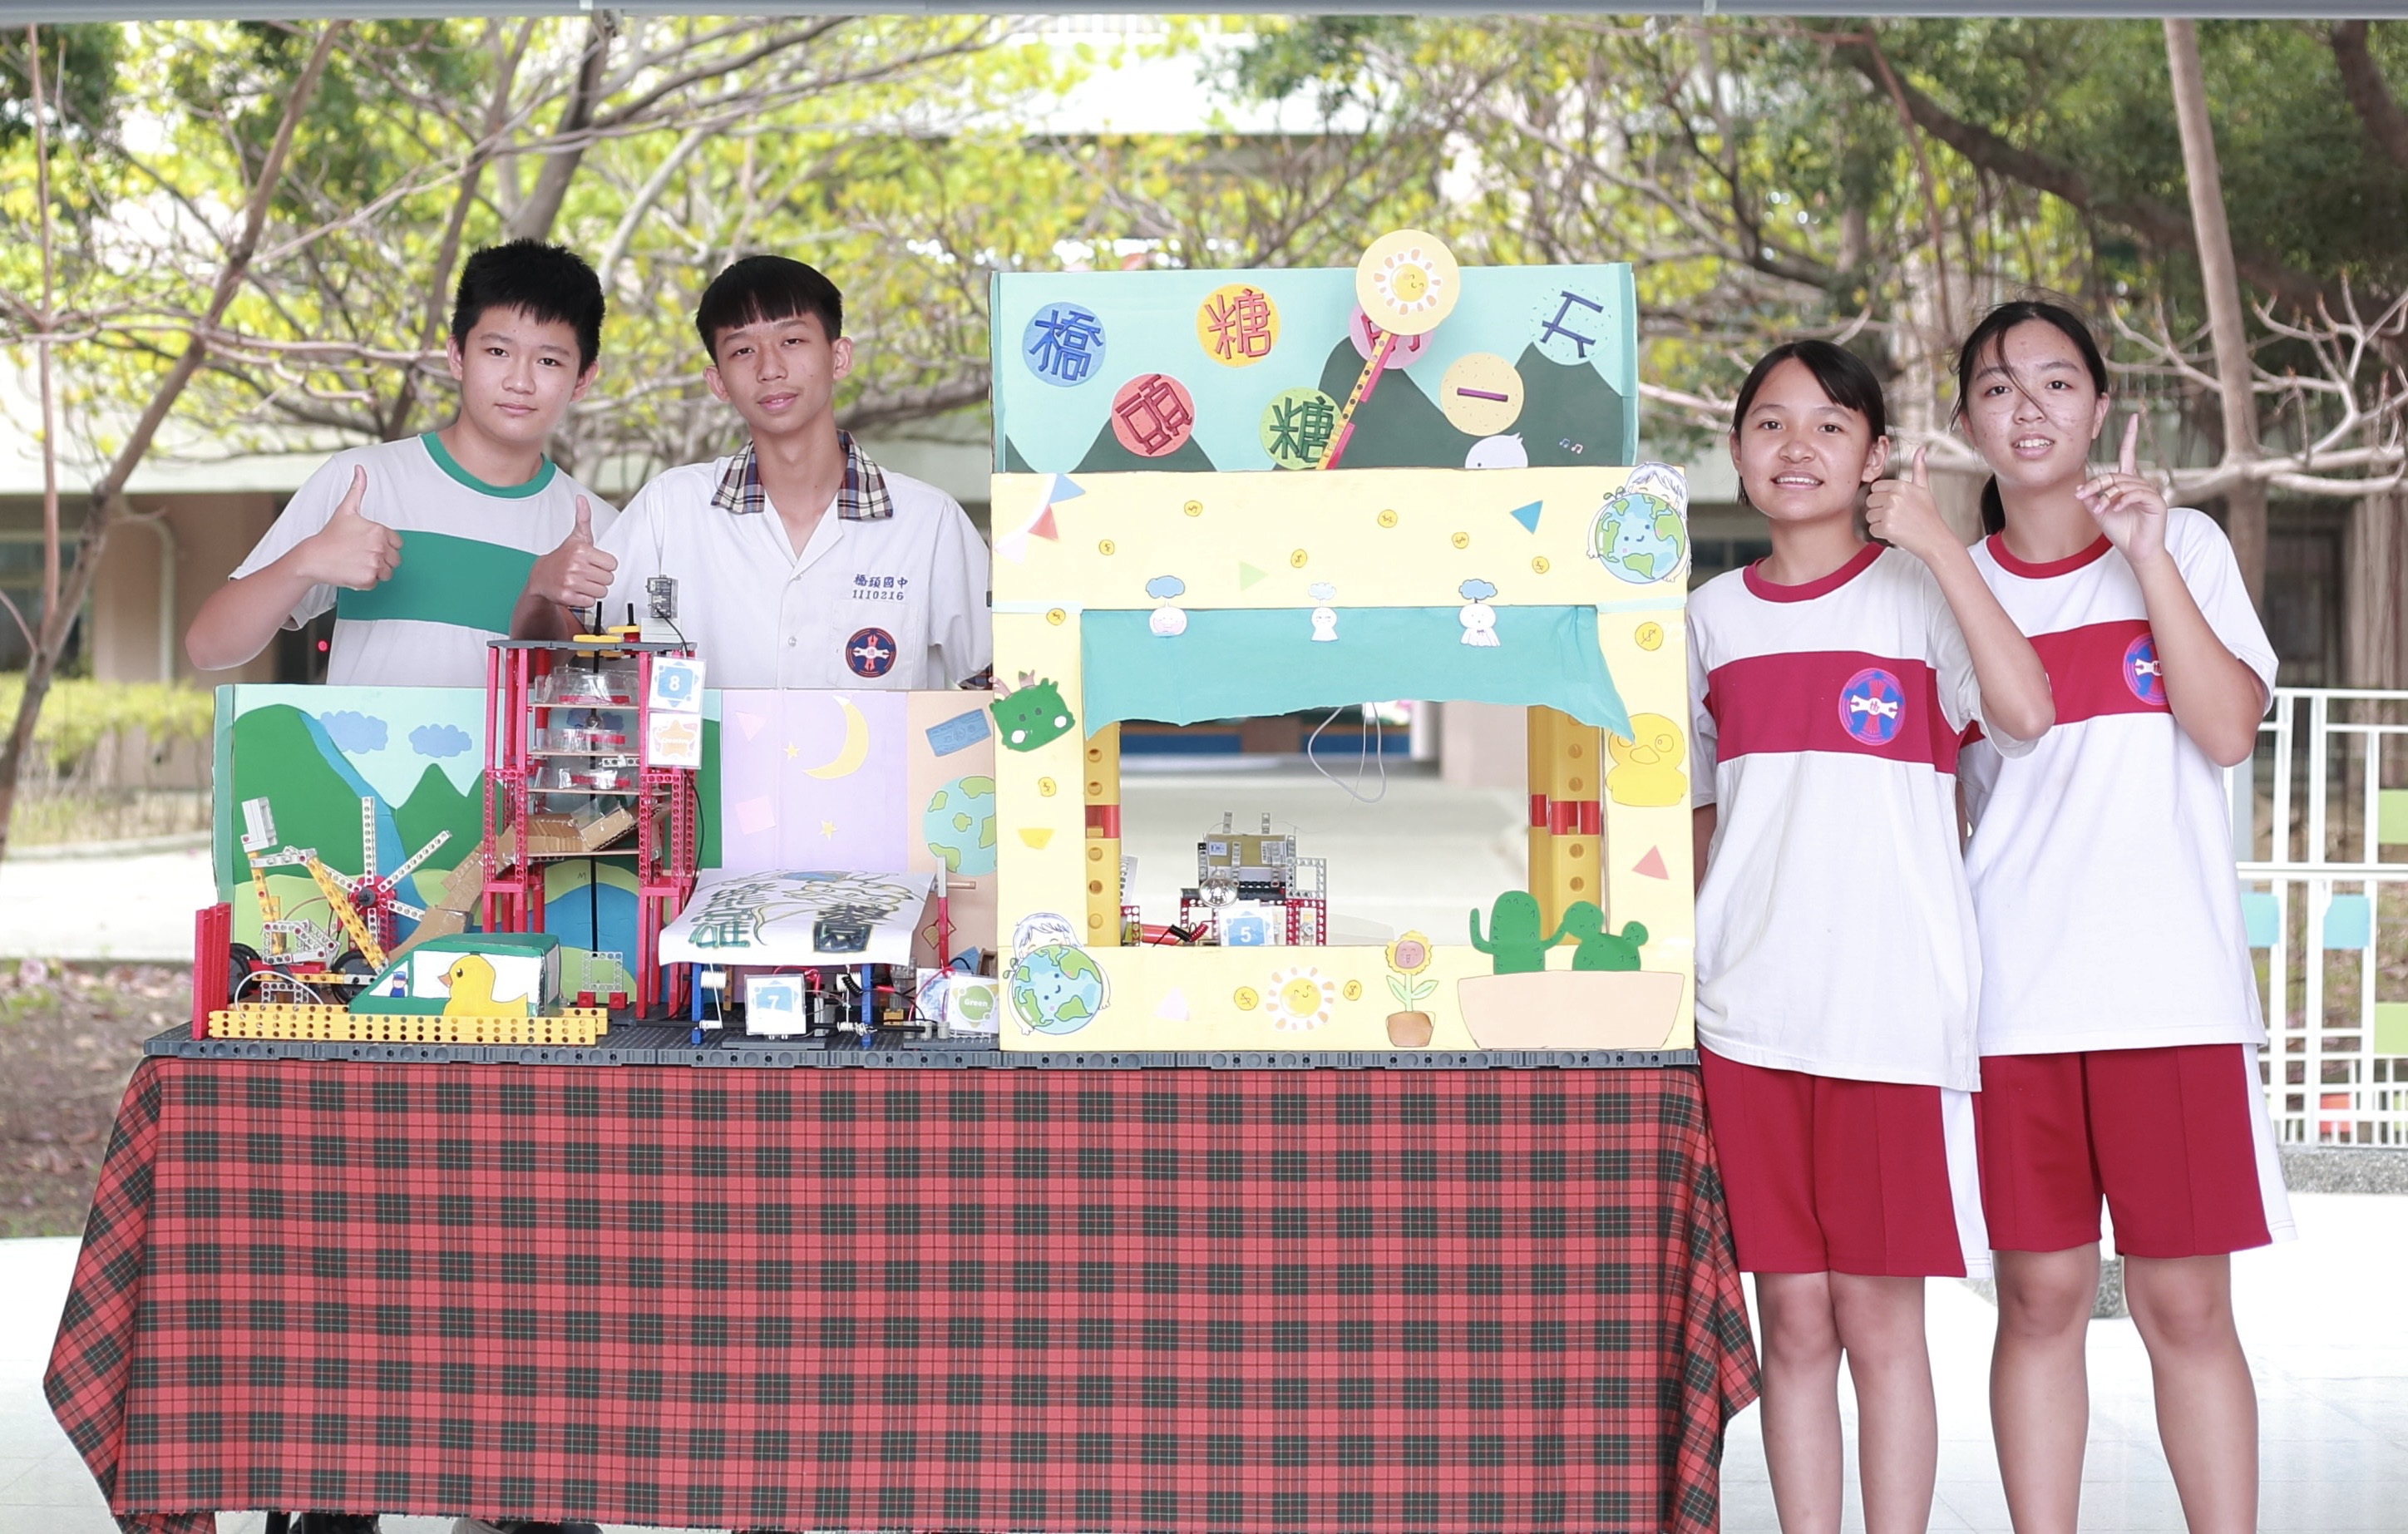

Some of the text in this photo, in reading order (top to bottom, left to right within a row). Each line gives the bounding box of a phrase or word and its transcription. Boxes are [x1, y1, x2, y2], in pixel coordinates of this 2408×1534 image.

[852, 589, 904, 600] 1110216
[669, 674, 680, 692] 8
[1241, 926, 1252, 943] 5
[767, 994, 780, 1010] 7
[964, 998, 989, 1008] Green
